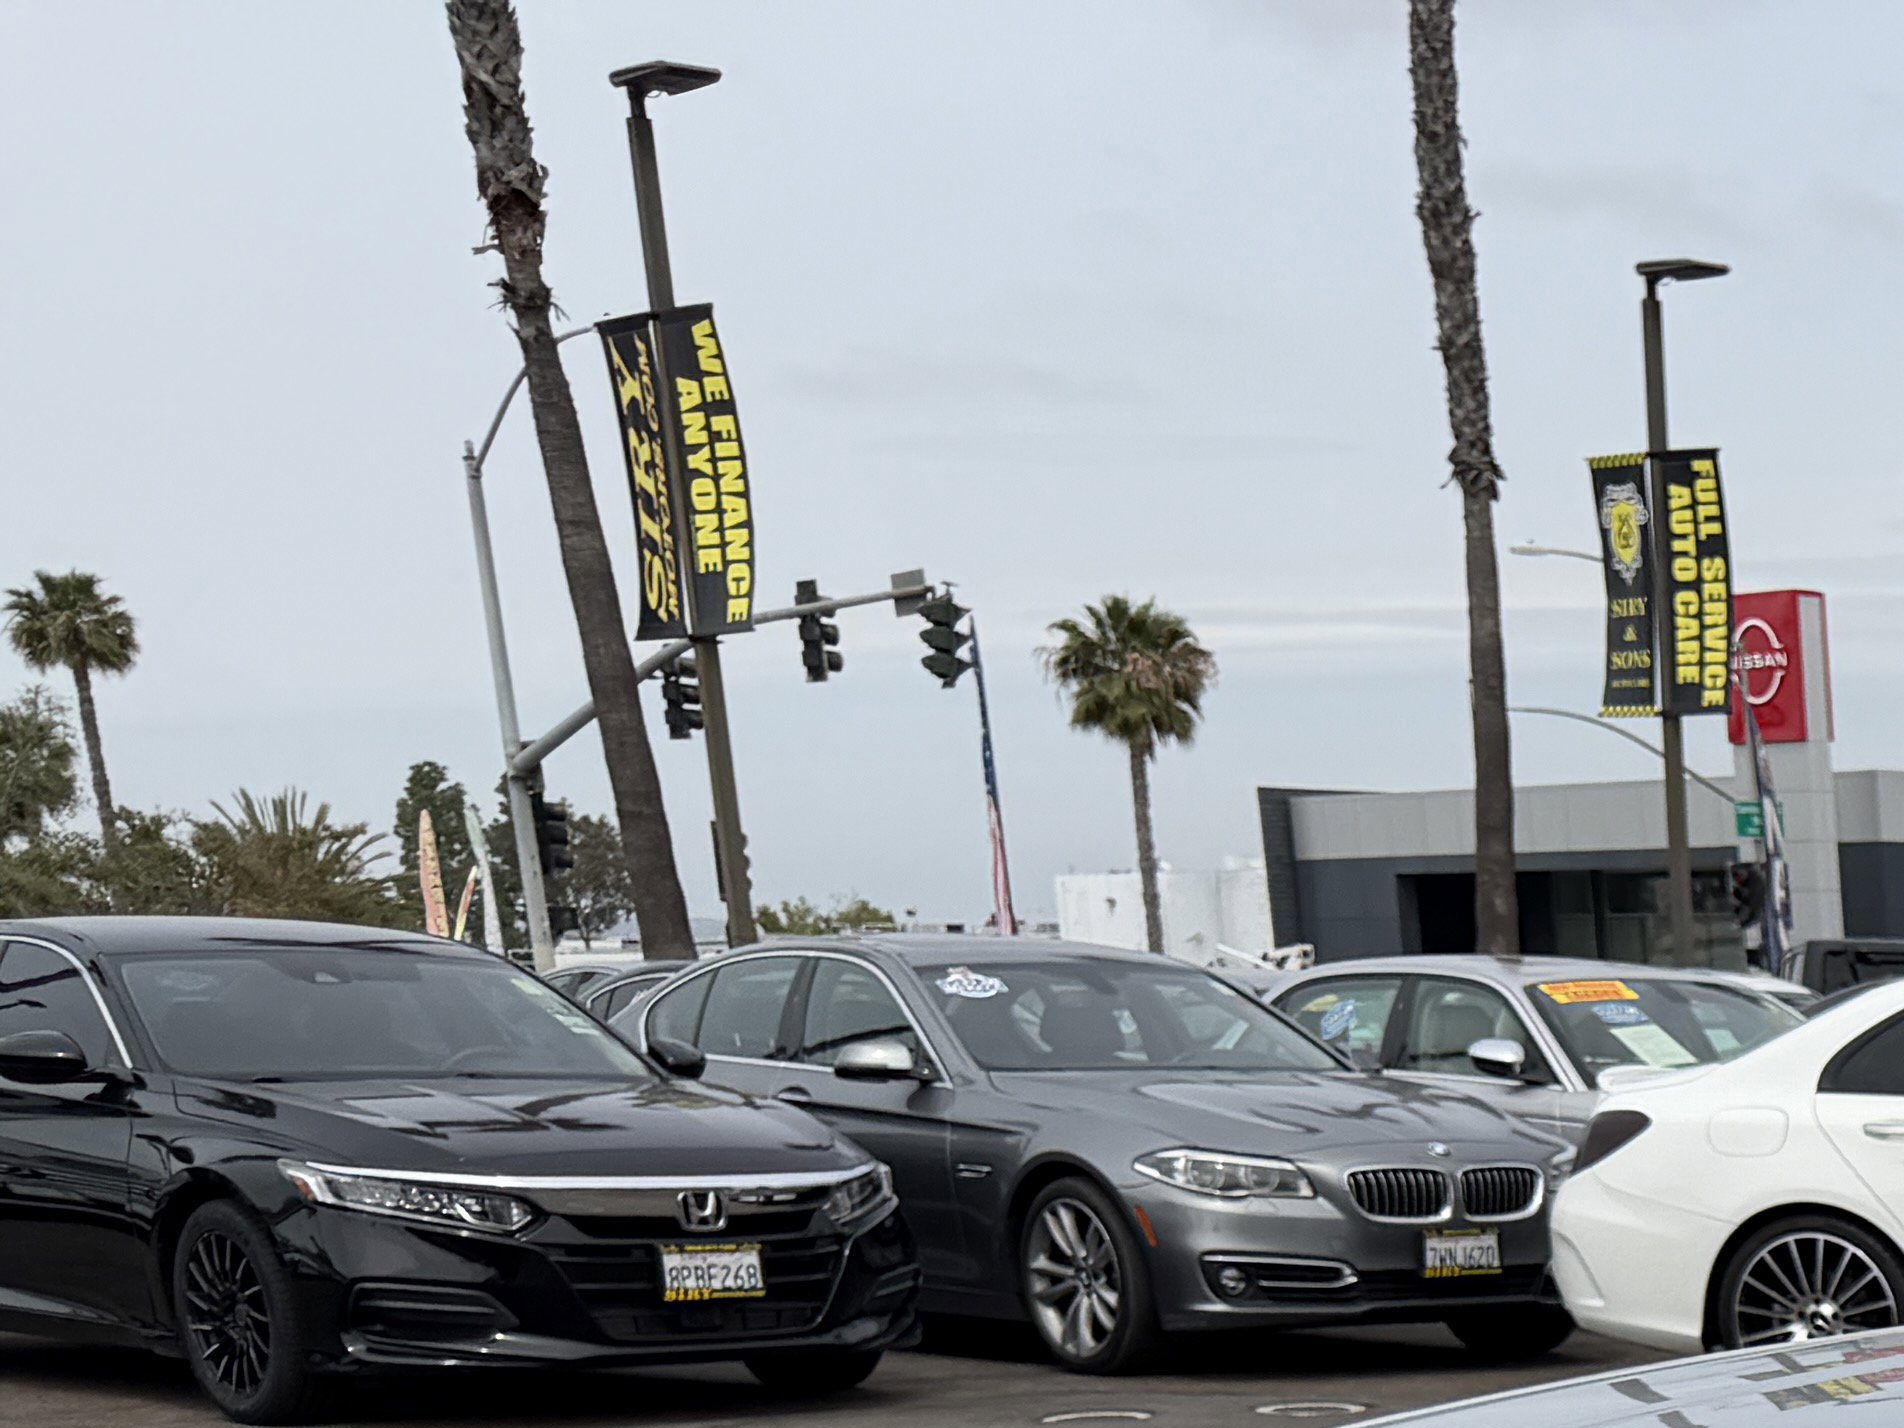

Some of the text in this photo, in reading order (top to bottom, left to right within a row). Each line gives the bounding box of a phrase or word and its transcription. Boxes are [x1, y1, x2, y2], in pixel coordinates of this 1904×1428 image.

[676, 376, 723, 575] ANYONE
[691, 318, 751, 624] WE FINANCE
[1690, 459, 1730, 709] FULL SERVICE
[1666, 483, 1700, 686] AUTO CARE
